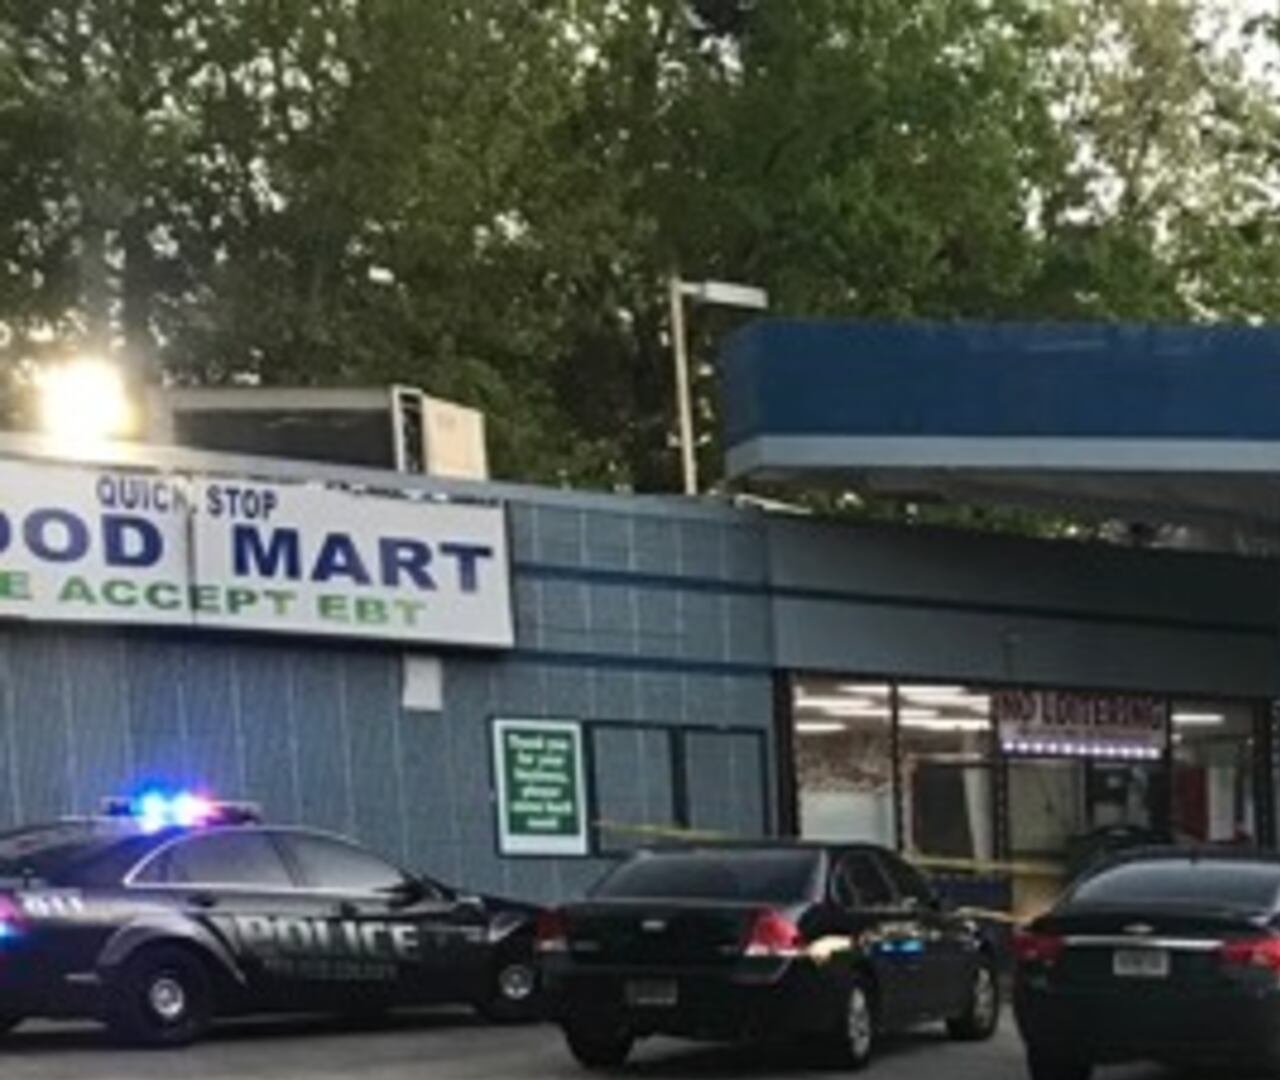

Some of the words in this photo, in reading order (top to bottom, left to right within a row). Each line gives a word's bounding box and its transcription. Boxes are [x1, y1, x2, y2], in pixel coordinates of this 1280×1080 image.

[206, 484, 278, 520] STOP
[0, 507, 164, 568] OD
[233, 524, 494, 594] MART
[58, 575, 296, 617] ACCEPT
[316, 594, 426, 626] EBT
[234, 915, 420, 958] POLICE
